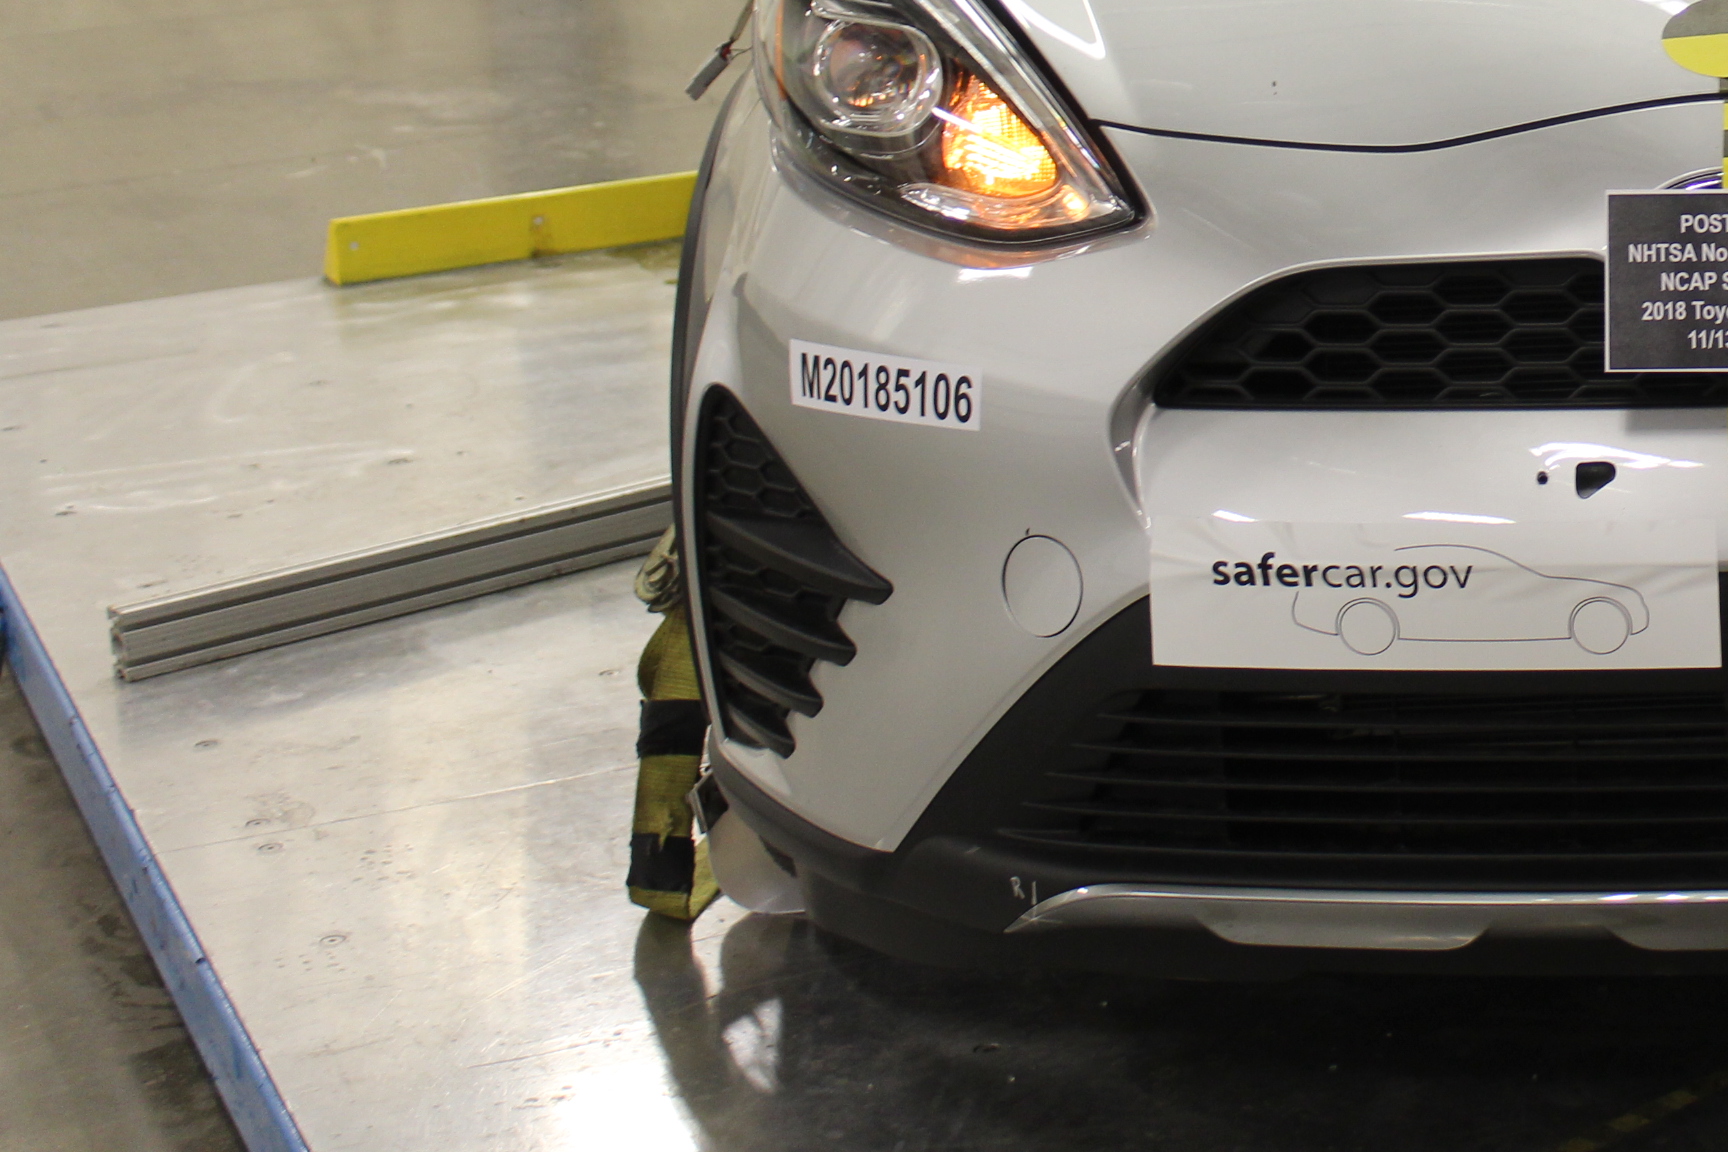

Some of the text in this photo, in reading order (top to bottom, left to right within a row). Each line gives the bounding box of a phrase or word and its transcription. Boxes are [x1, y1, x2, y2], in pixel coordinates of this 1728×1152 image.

[1628, 243, 1696, 263] NHTSA
[1660, 272, 1717, 291] NCAP
[1641, 301, 1687, 321] 2018
[800, 352, 973, 423] M20185106
[1212, 552, 1473, 599] safercar.gov
